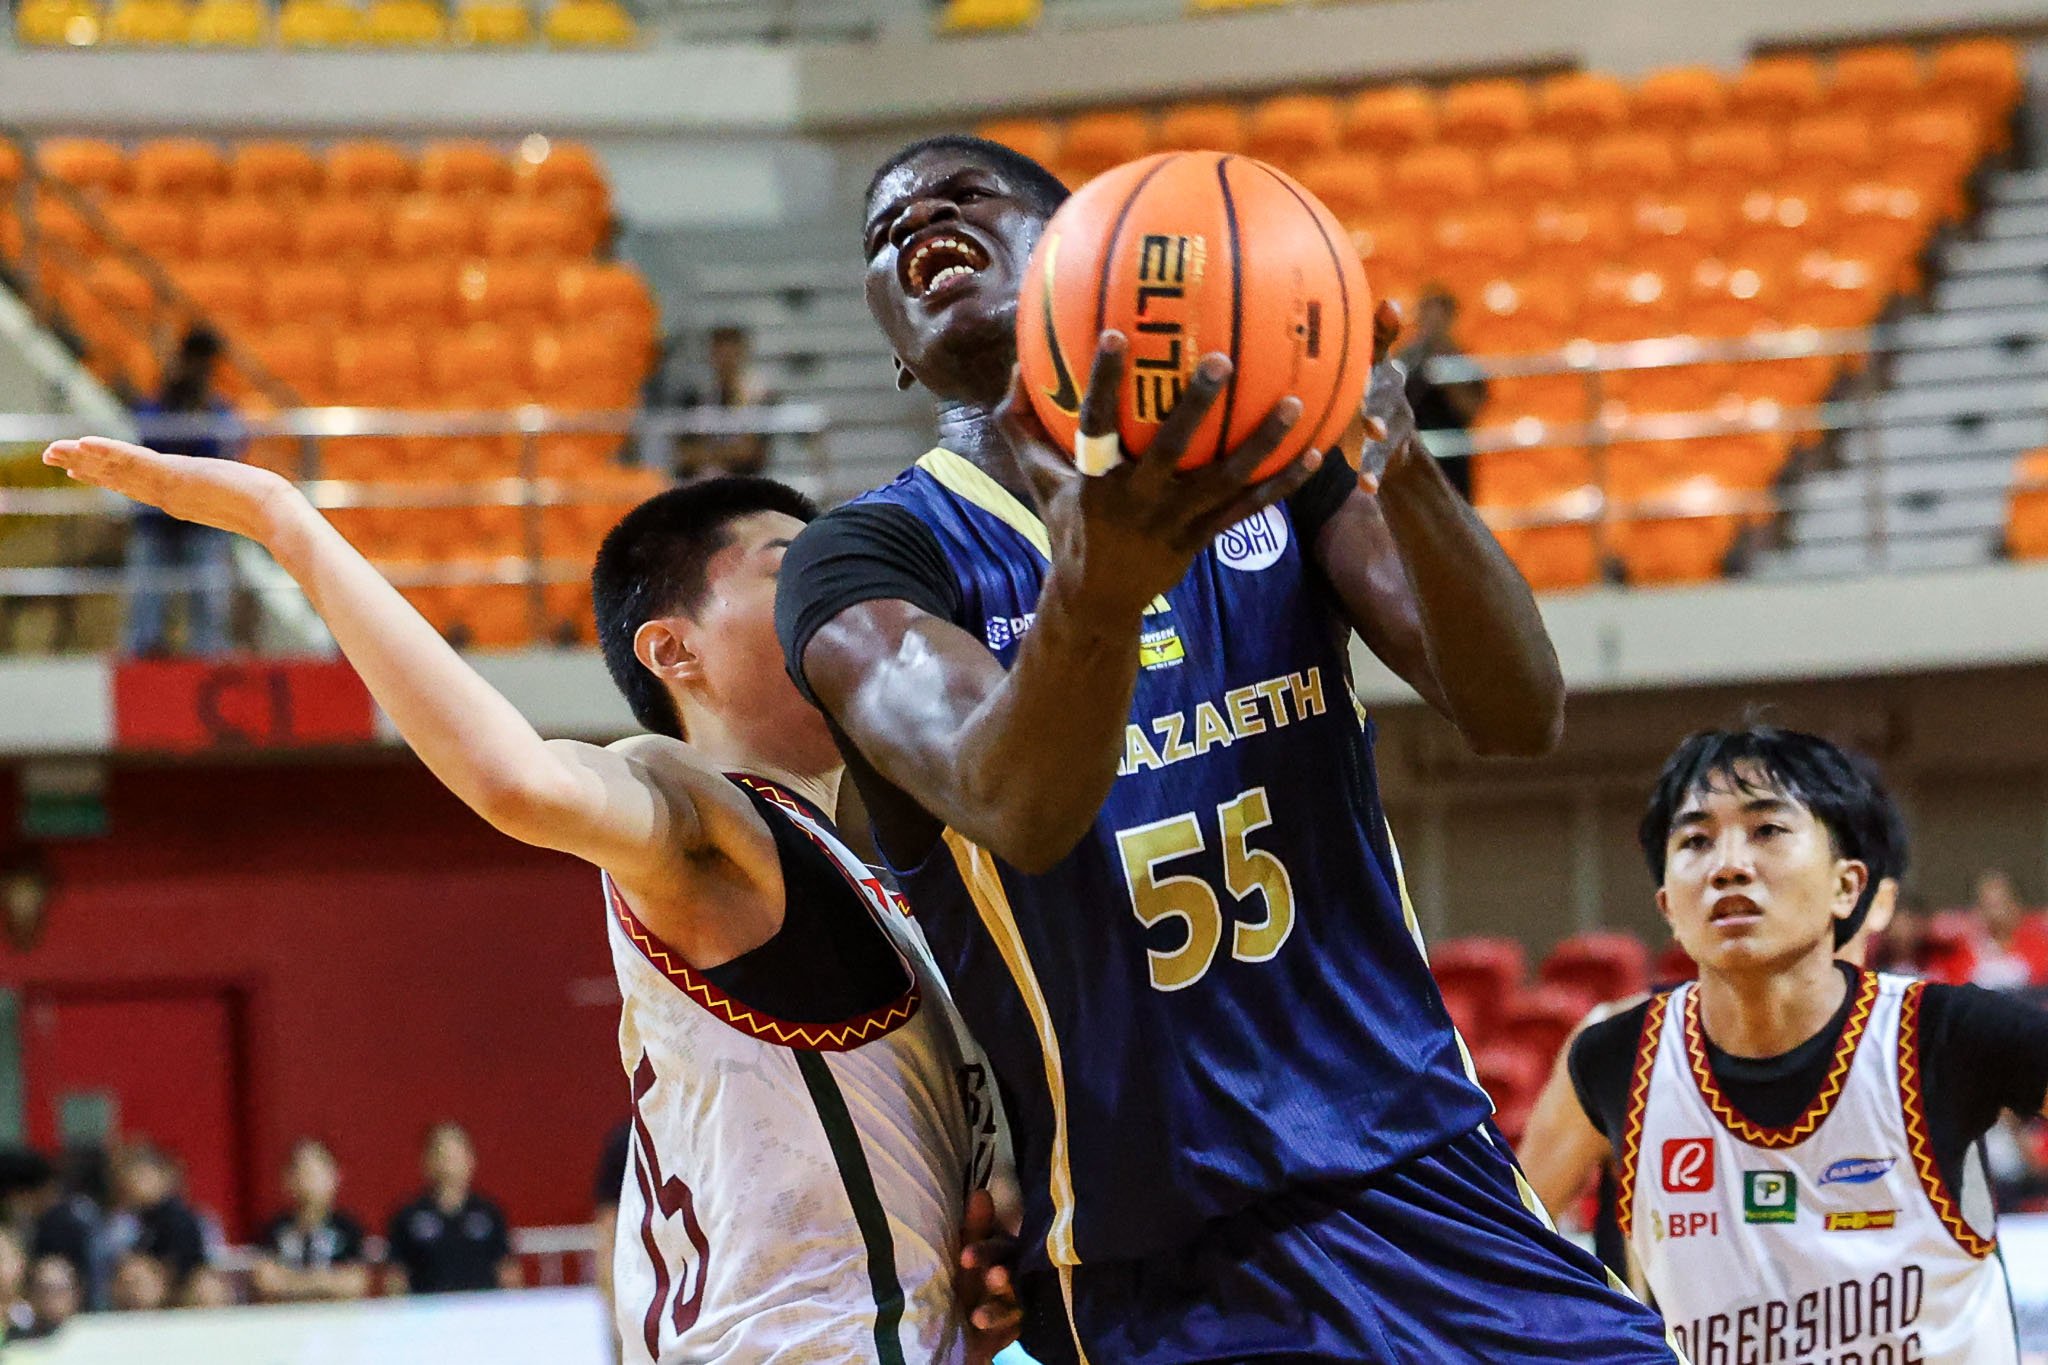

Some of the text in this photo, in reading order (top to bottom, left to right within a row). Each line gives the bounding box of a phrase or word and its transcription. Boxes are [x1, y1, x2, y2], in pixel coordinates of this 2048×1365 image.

[1135, 234, 1188, 421] ELITE
[1116, 666, 1327, 776] AZAETH
[1115, 786, 1296, 992] 55
[1668, 1211, 1718, 1237] BPI
